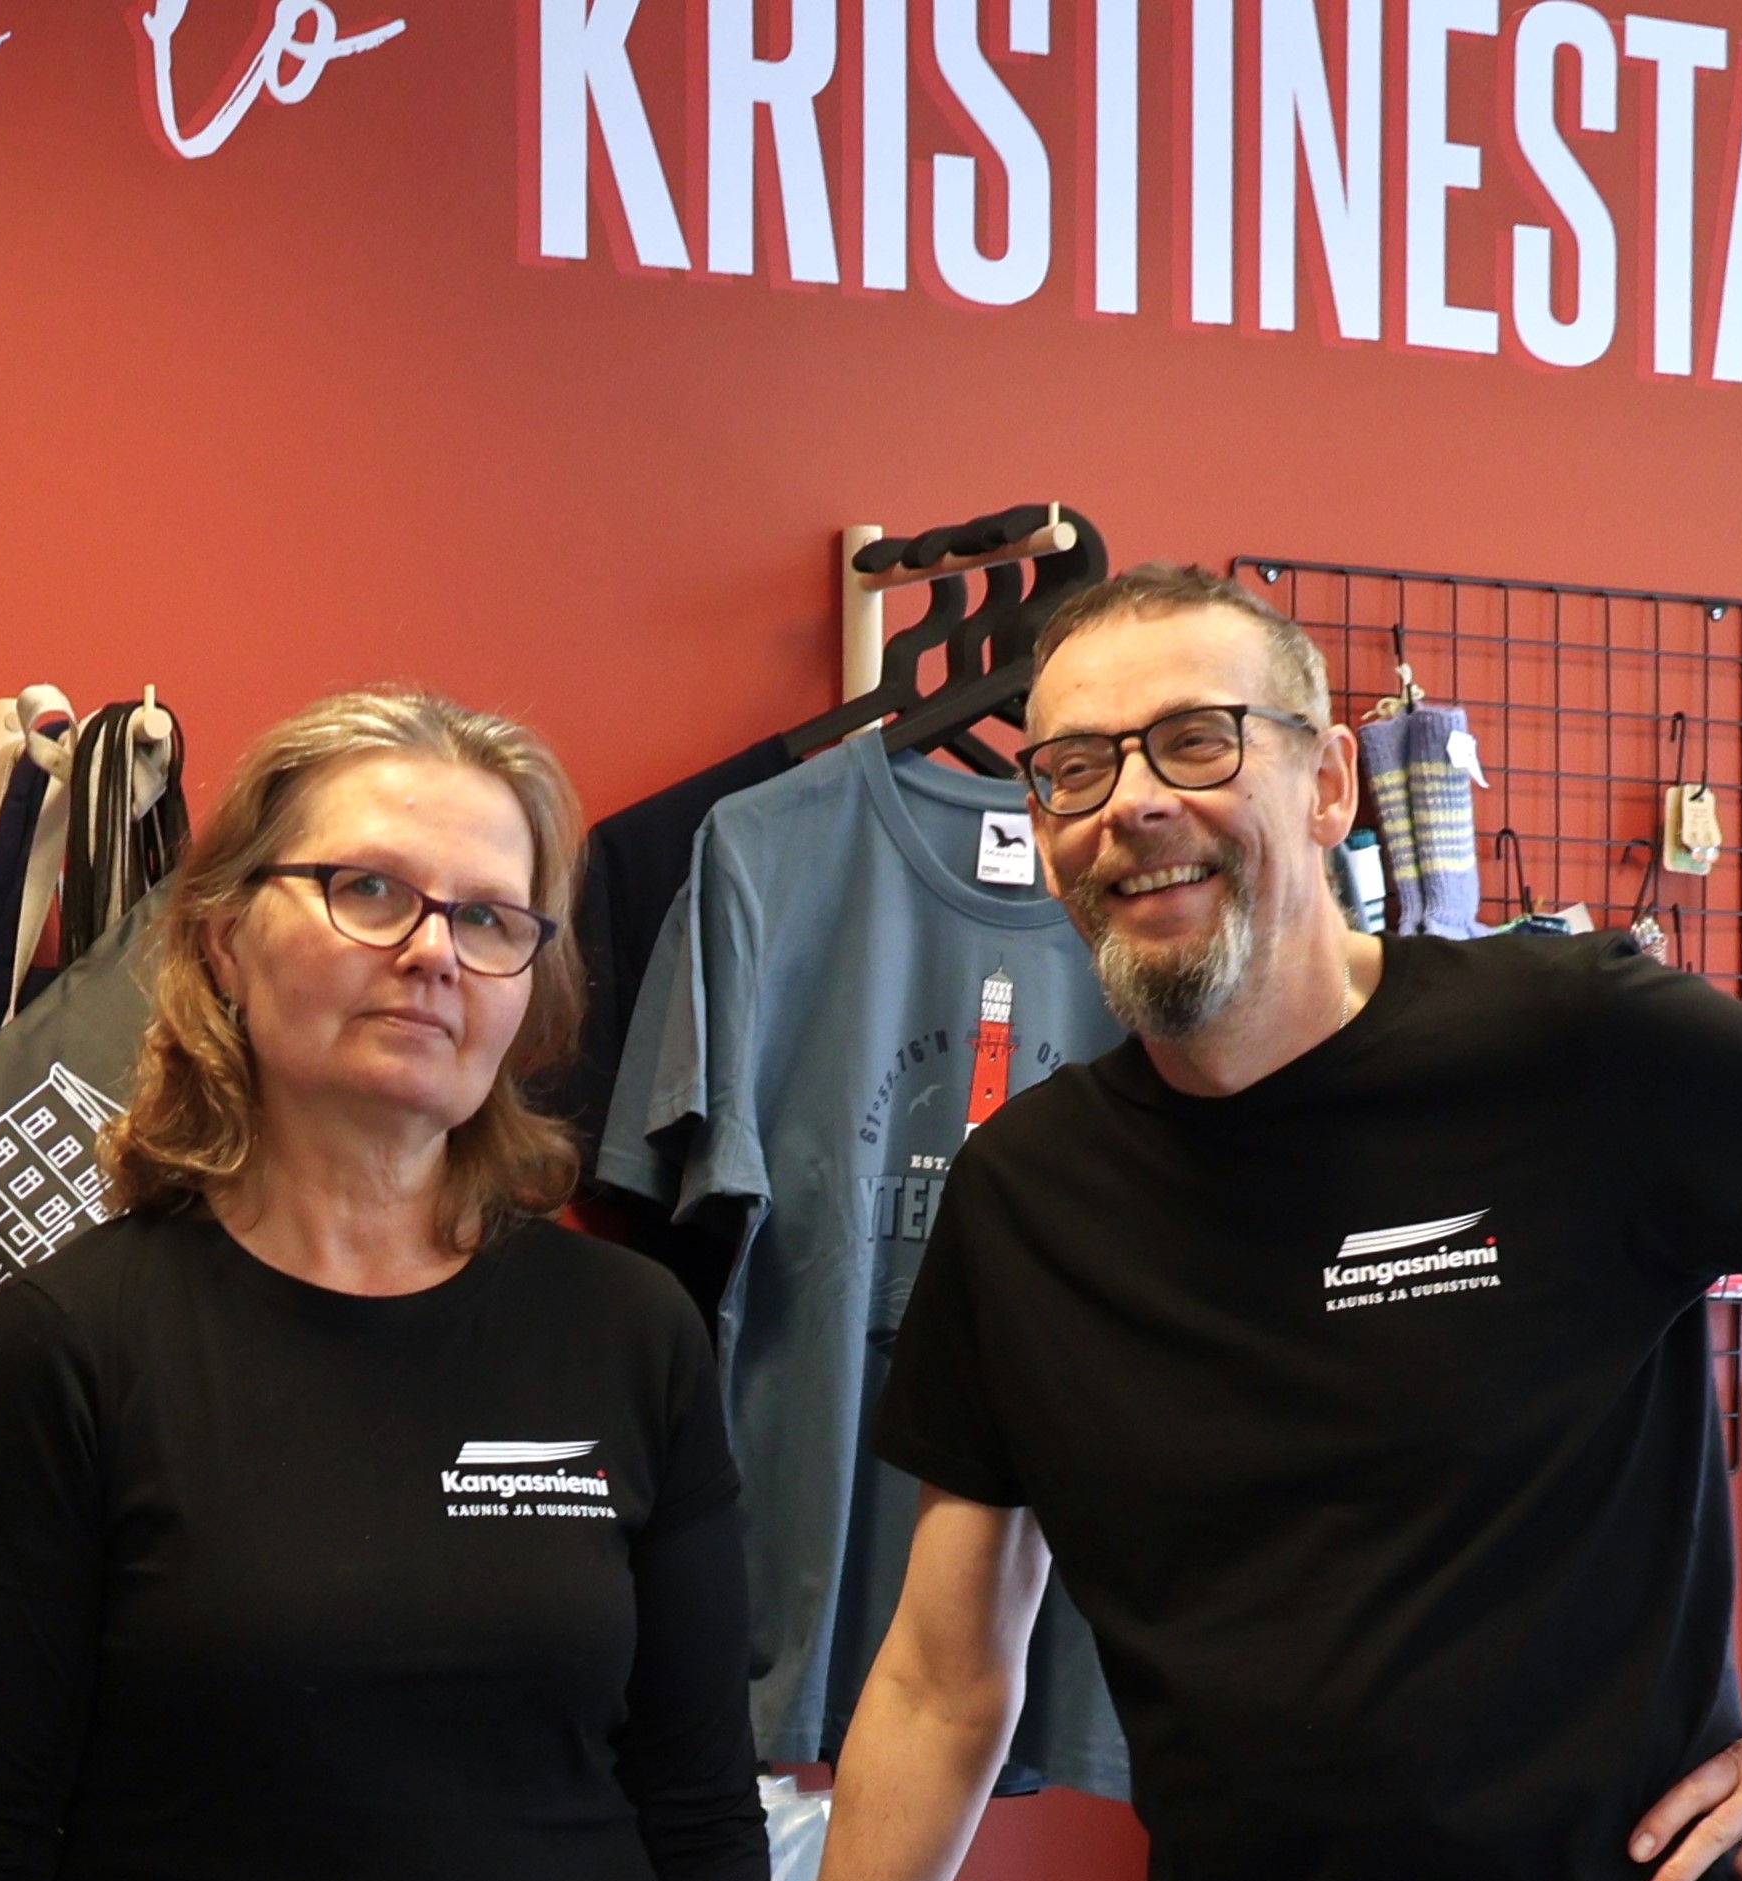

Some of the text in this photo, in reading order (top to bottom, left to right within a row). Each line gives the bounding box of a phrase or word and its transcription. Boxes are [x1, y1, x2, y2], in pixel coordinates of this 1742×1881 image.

[142, 0, 407, 158] to
[909, 1154, 951, 1171] EST.
[1323, 1235, 1499, 1288] Kangasniemi
[1326, 1273, 1502, 1312] KAUNIS JA UUDISTUVA
[441, 1467, 609, 1498] Kangasniemi
[447, 1503, 618, 1519] KAUNIS JA UUDISTUVA
